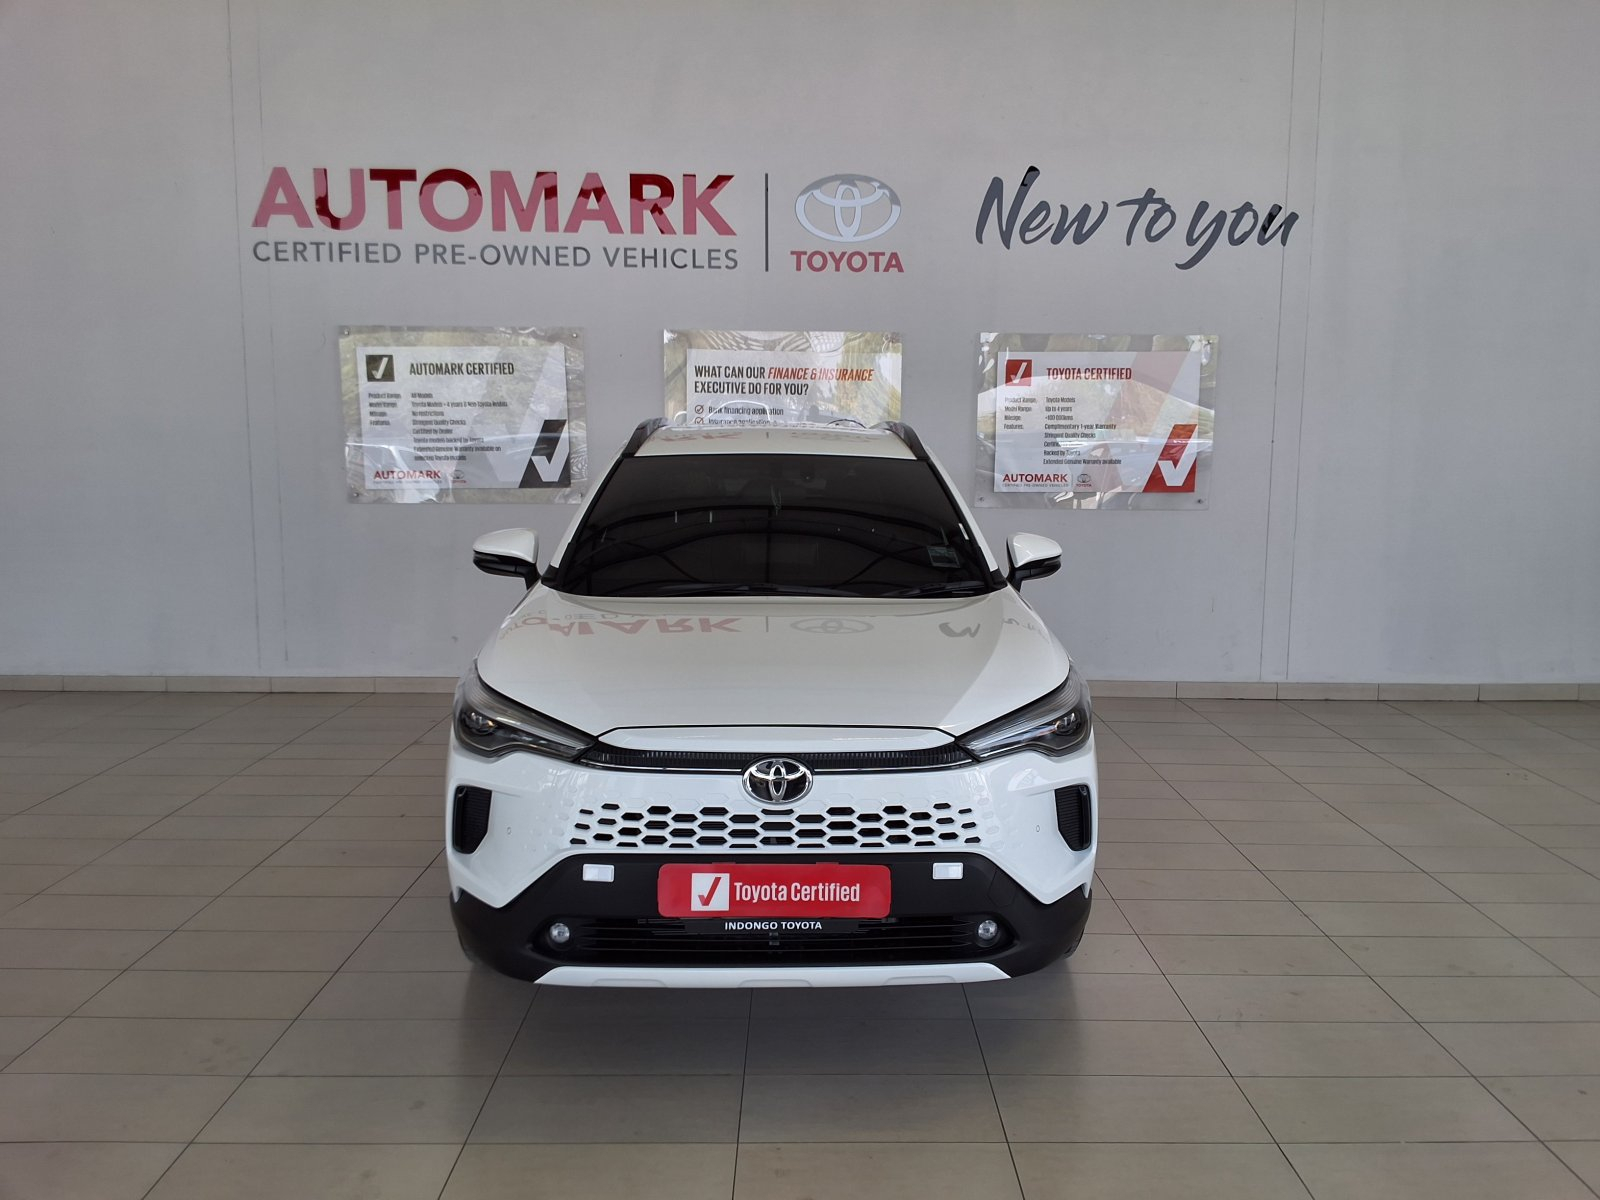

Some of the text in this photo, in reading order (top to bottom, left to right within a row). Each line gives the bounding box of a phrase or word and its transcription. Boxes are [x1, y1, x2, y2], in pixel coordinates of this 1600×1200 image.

[250, 166, 738, 237] AUTOMARK
[975, 165, 1299, 271] New to you
[252, 241, 738, 270] CERTIFIED PRE-OWNED VEHICLES
[790, 250, 904, 273] TOYOTA
[409, 362, 514, 376] AUTOMARK CERTIFIED
[694, 365, 875, 382] WHAT CAN OUR FINANCE & INSURANCE
[1046, 367, 1132, 380] TOYOTA CERTIFIED
[694, 381, 809, 396] EXECUTIVE DO FOR YOU?
[723, 406, 751, 416] financing
[751, 407, 784, 416] appliation
[374, 470, 441, 480] AUTOMARK
[1002, 473, 1068, 483] AUTOMARK
[733, 882, 860, 904] Toyota Certified
[724, 921, 822, 930] INDONGO TOYOTA
